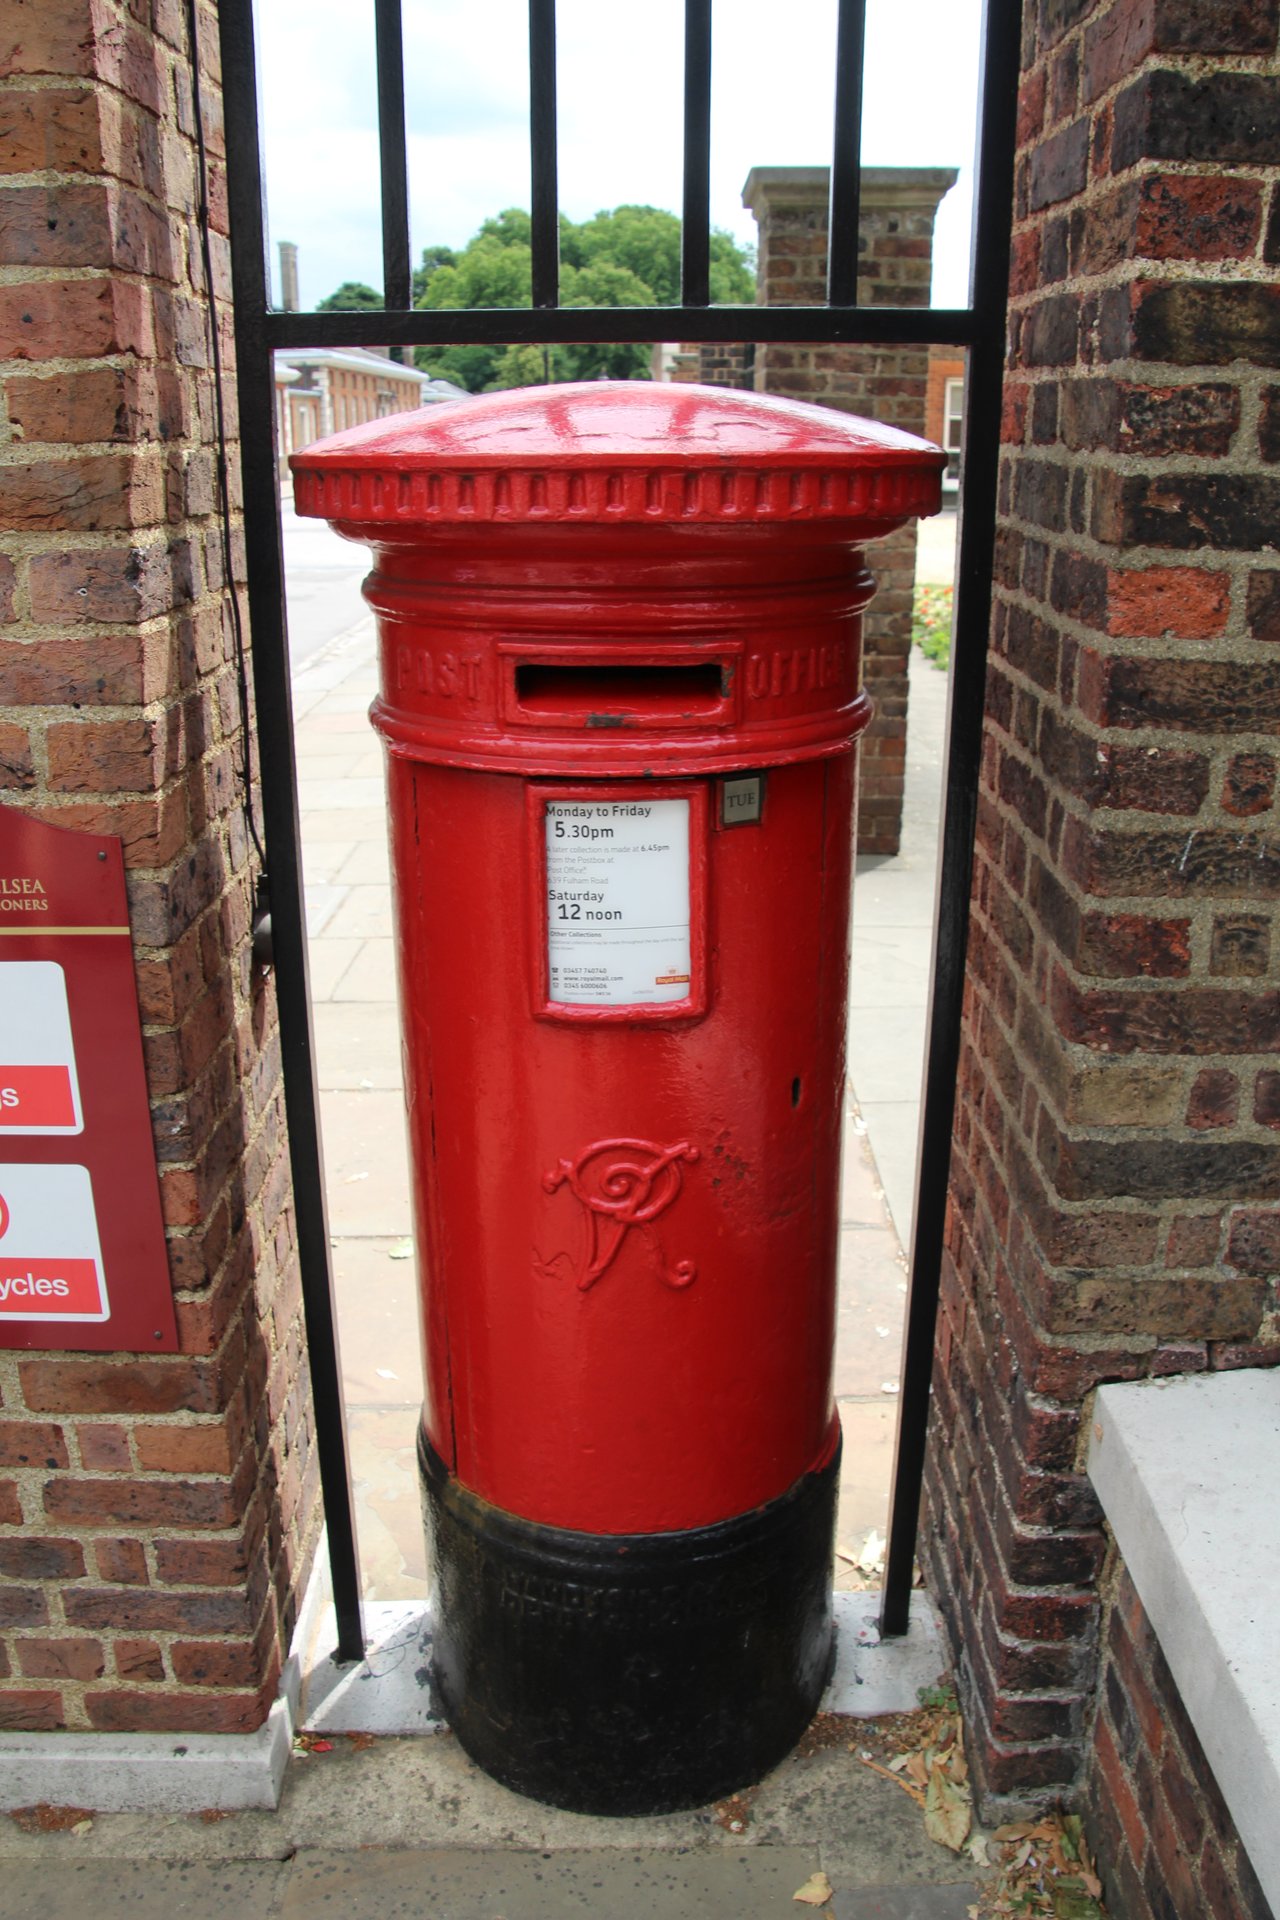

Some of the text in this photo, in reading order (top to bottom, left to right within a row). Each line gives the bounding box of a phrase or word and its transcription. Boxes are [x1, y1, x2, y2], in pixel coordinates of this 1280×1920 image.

[397, 641, 846, 702] POST OFFICE
[727, 791, 756, 808] TUE
[546, 804, 652, 819] Monday to Friday
[555, 821, 614, 841] 5.30pm
[641, 844, 670, 852] 6.45pm
[577, 855, 605, 863] Postbox
[562, 876, 590, 884] Fulham
[590, 876, 609, 884] Road
[549, 889, 605, 903] Saturday
[557, 903, 623, 920] 12 noon
